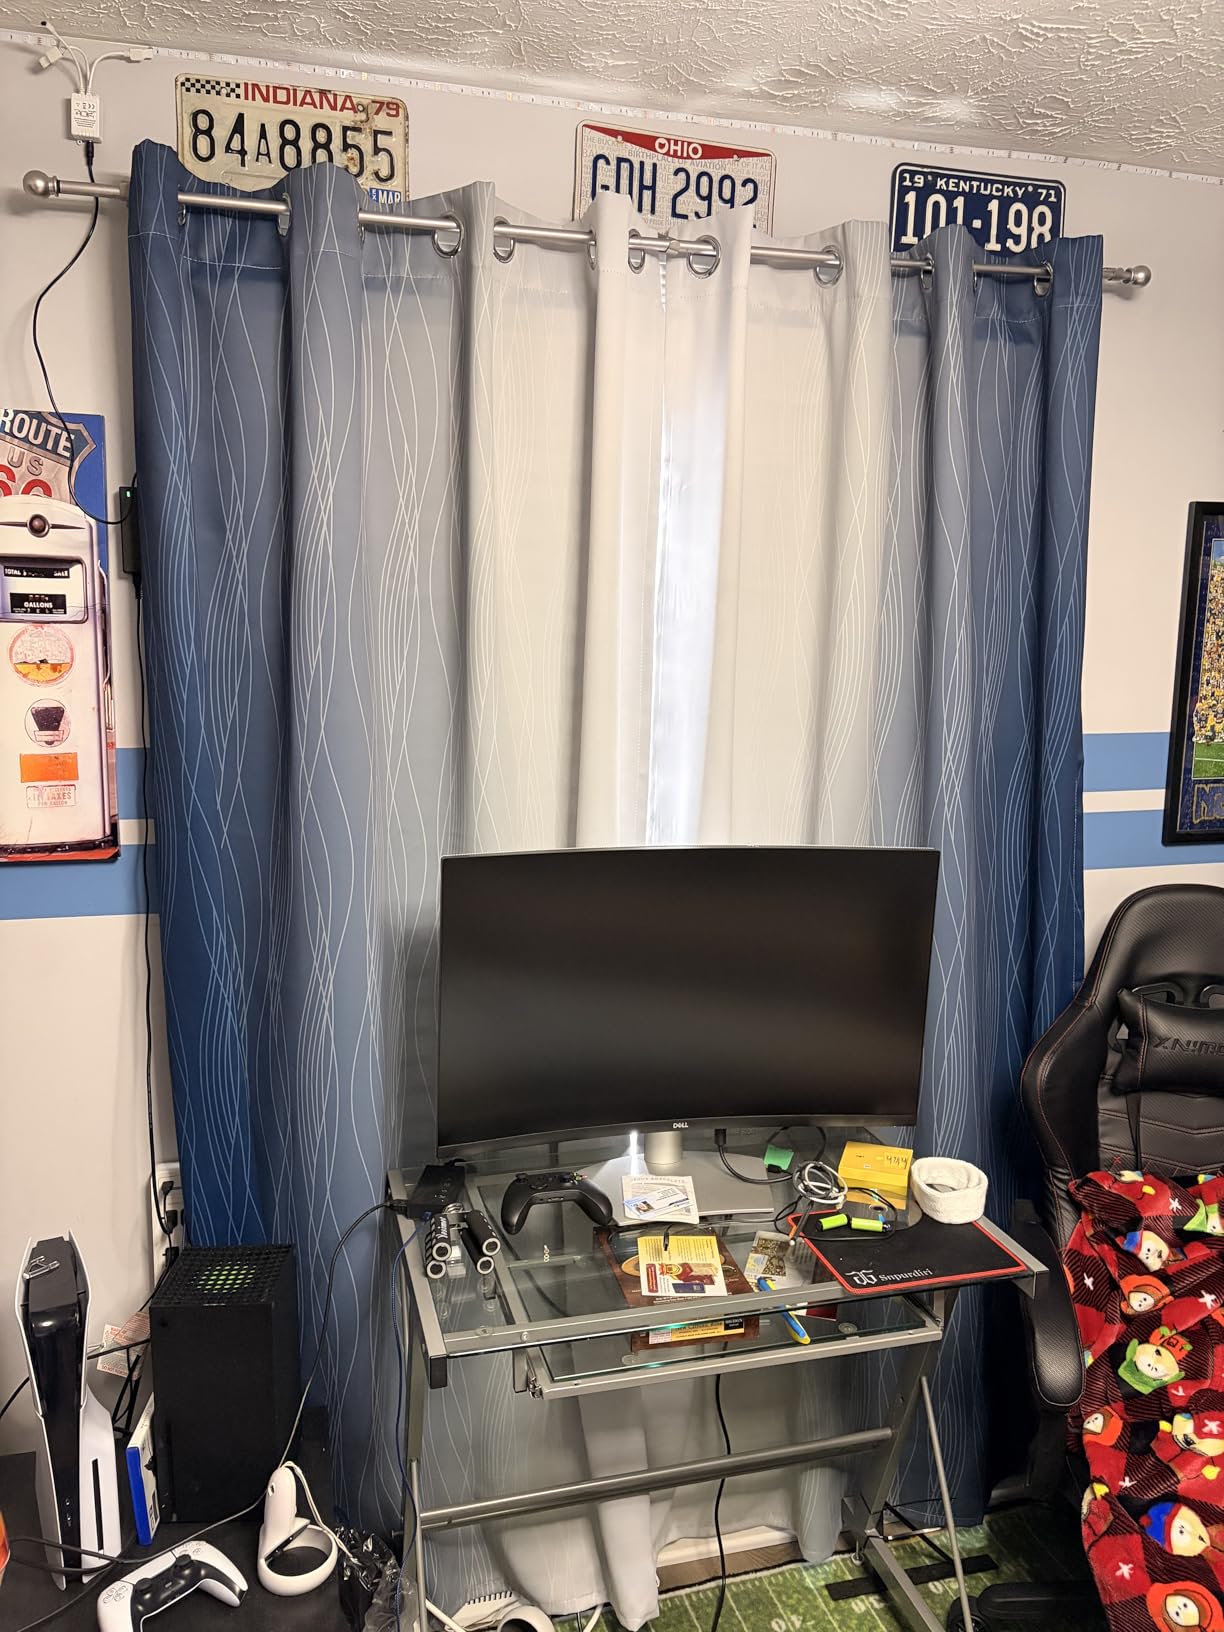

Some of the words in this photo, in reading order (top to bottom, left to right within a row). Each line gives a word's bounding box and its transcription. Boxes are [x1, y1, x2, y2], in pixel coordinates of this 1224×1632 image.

[243, 82, 358, 113] INDIANA
[371, 100, 400, 118] 79
[655, 138, 703, 159] OHIO
[591, 154, 658, 215] GDH
[902, 173, 924, 187] 19
[936, 177, 1026, 198] KENTUCKY
[1037, 189, 1057, 202] 71
[0, 408, 75, 458] ROUTE
[7, 446, 44, 476] US
